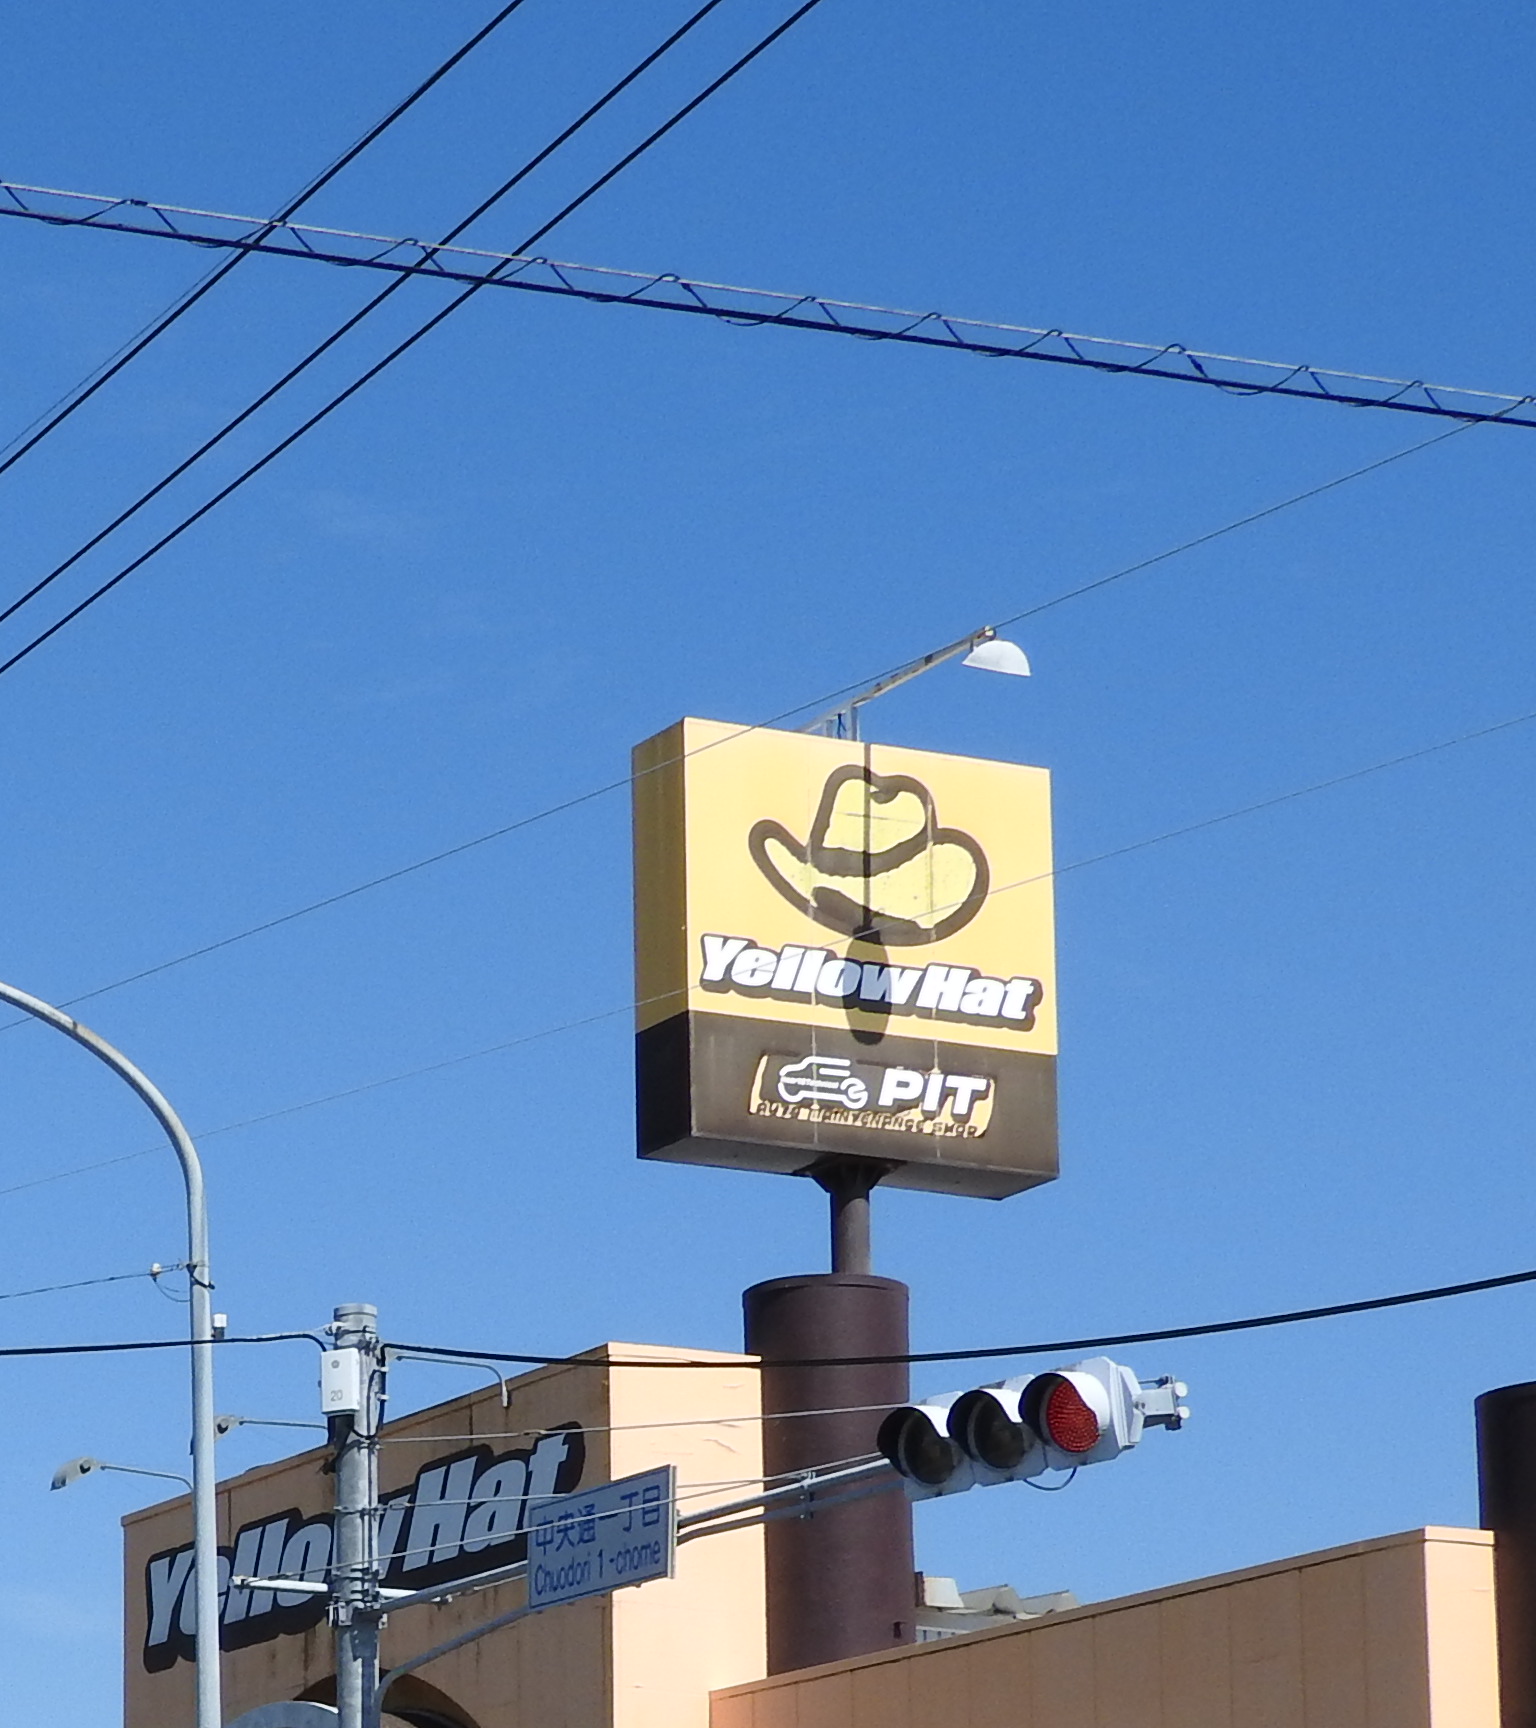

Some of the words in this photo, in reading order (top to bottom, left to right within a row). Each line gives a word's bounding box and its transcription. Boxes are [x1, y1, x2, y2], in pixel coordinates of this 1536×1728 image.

[878, 1068, 987, 1115] PIT
[330, 1389, 344, 1401] 20
[534, 1484, 661, 1556] 中央通一丁目
[534, 1551, 591, 1596] Chuodori
